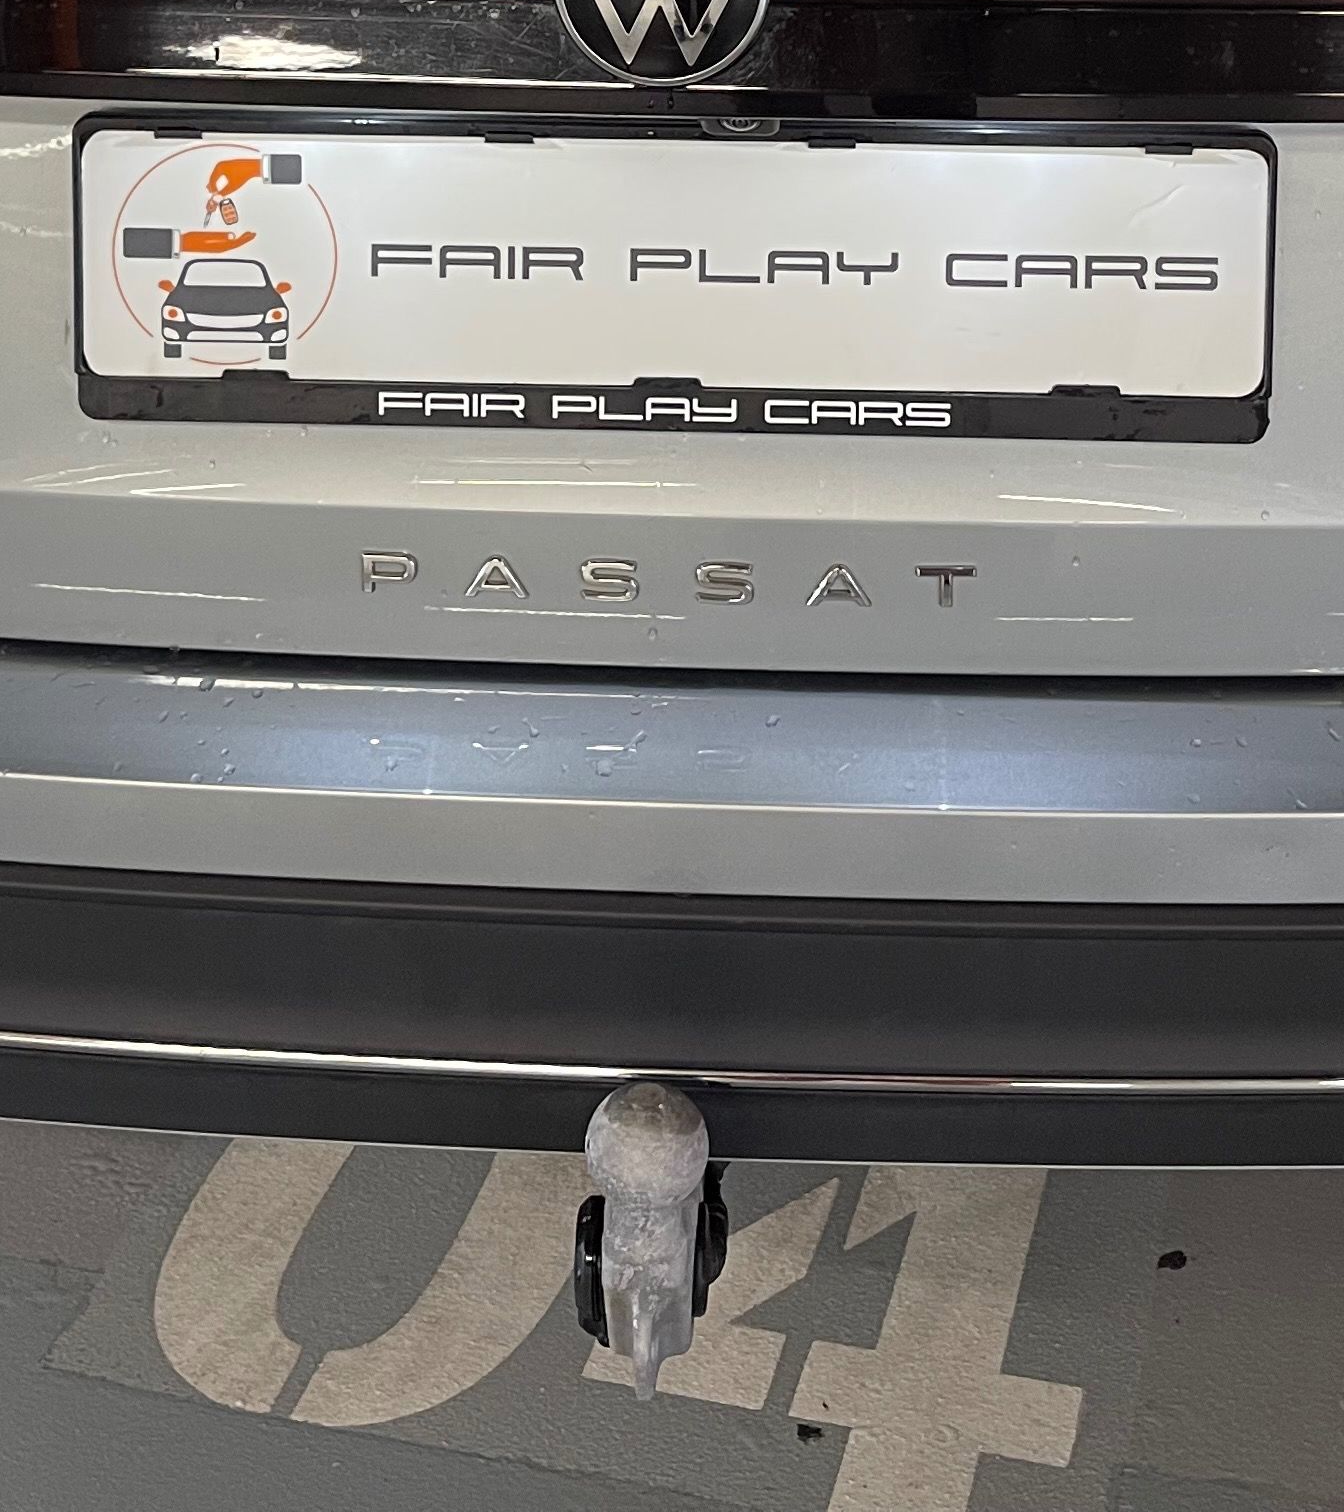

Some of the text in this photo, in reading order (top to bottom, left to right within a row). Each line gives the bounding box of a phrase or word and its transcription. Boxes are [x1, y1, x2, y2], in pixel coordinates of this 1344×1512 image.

[370, 242, 1219, 292] FAIR PLAY CARS
[376, 390, 953, 429] FAIR PLAY CARS
[359, 550, 980, 609] PASSAT
